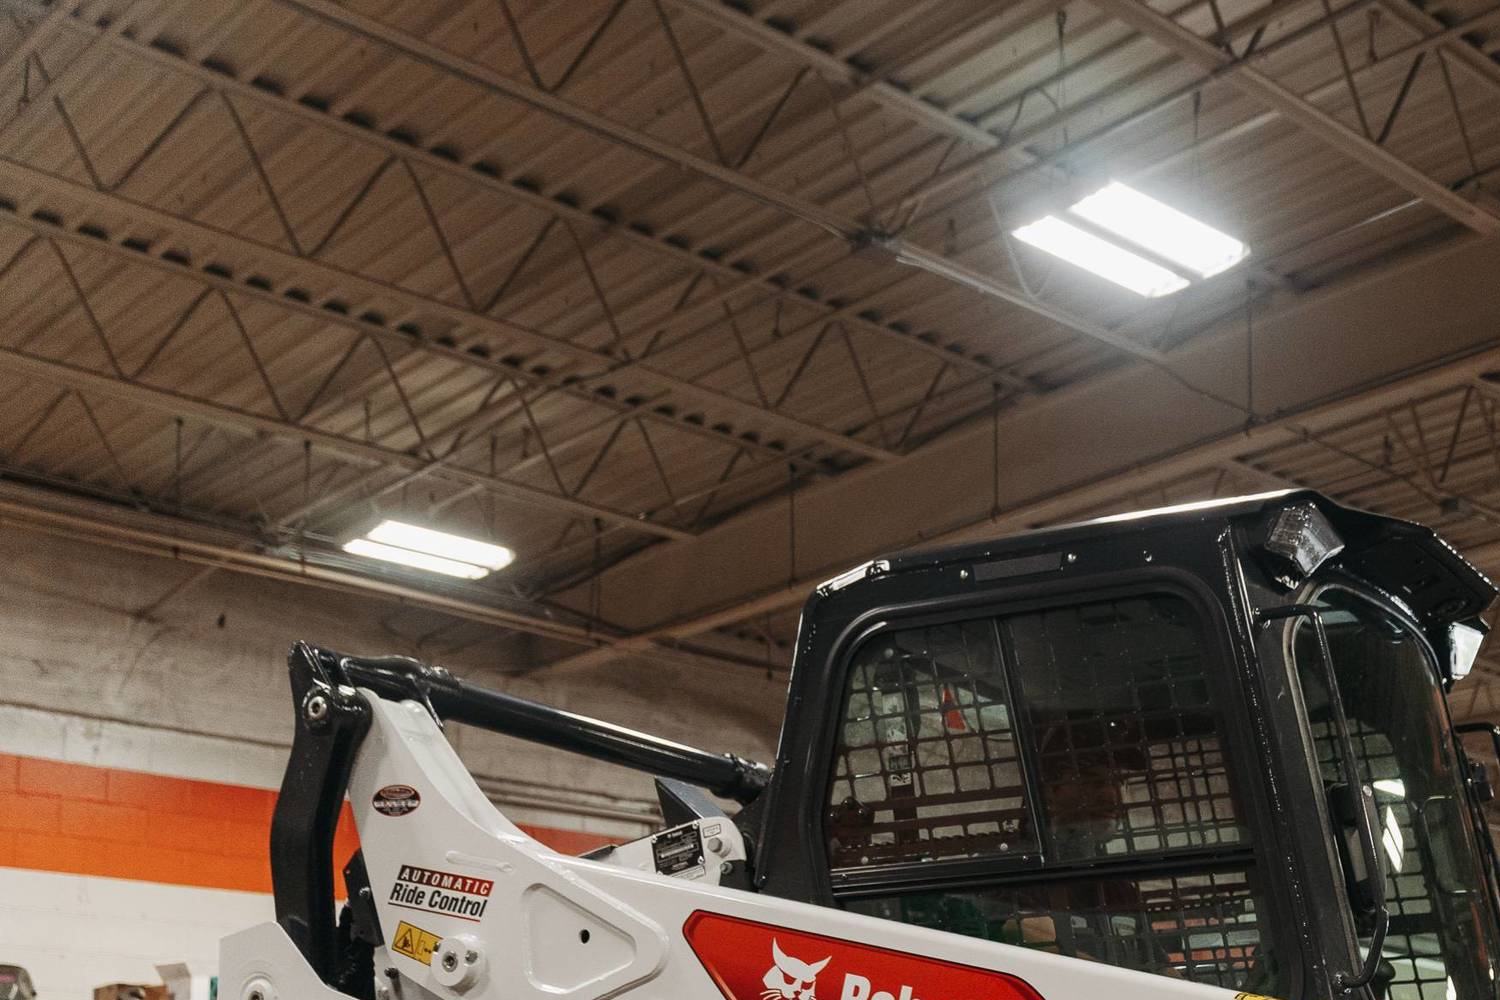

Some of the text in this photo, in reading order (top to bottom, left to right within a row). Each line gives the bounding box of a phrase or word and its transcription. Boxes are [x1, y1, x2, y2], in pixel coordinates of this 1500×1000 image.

[401, 867, 491, 895] AUTOMATIC
[389, 882, 488, 918] Ride Control
